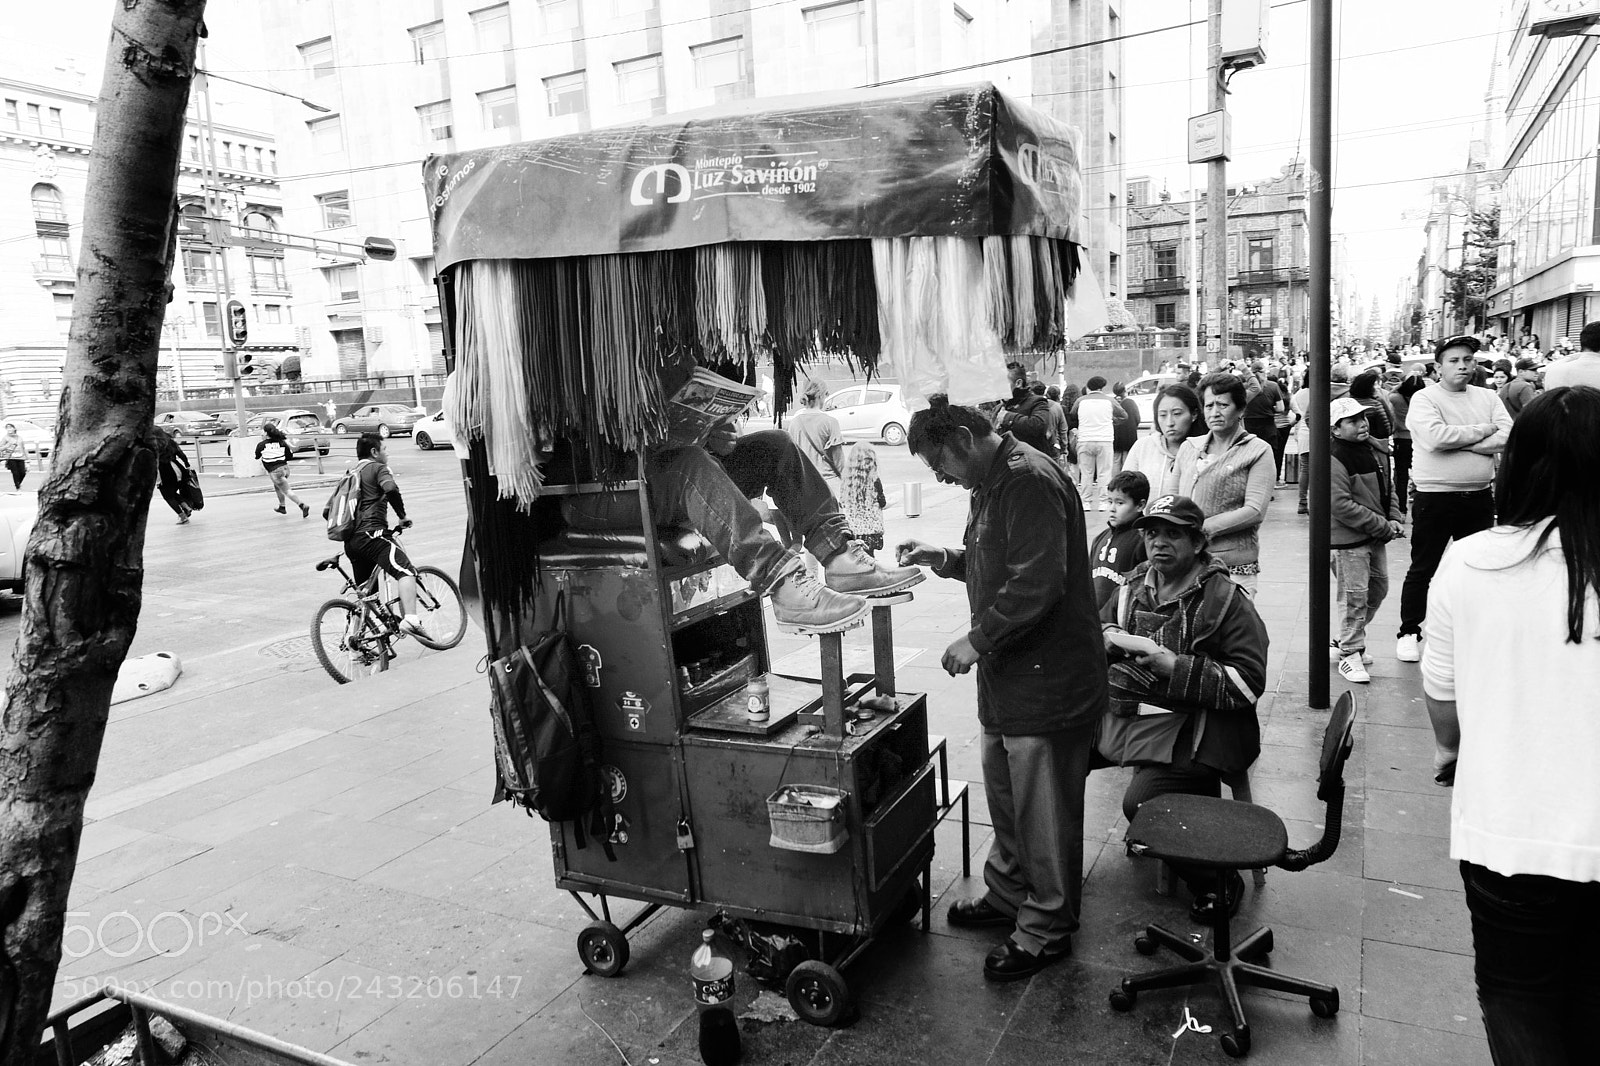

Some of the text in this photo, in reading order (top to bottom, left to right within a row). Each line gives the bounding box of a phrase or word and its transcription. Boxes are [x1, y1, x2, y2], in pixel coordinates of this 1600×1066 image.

[695, 154, 742, 170] Montepío
[694, 160, 817, 190] Luz Saviñón
[762, 183, 816, 195] desde 1902
